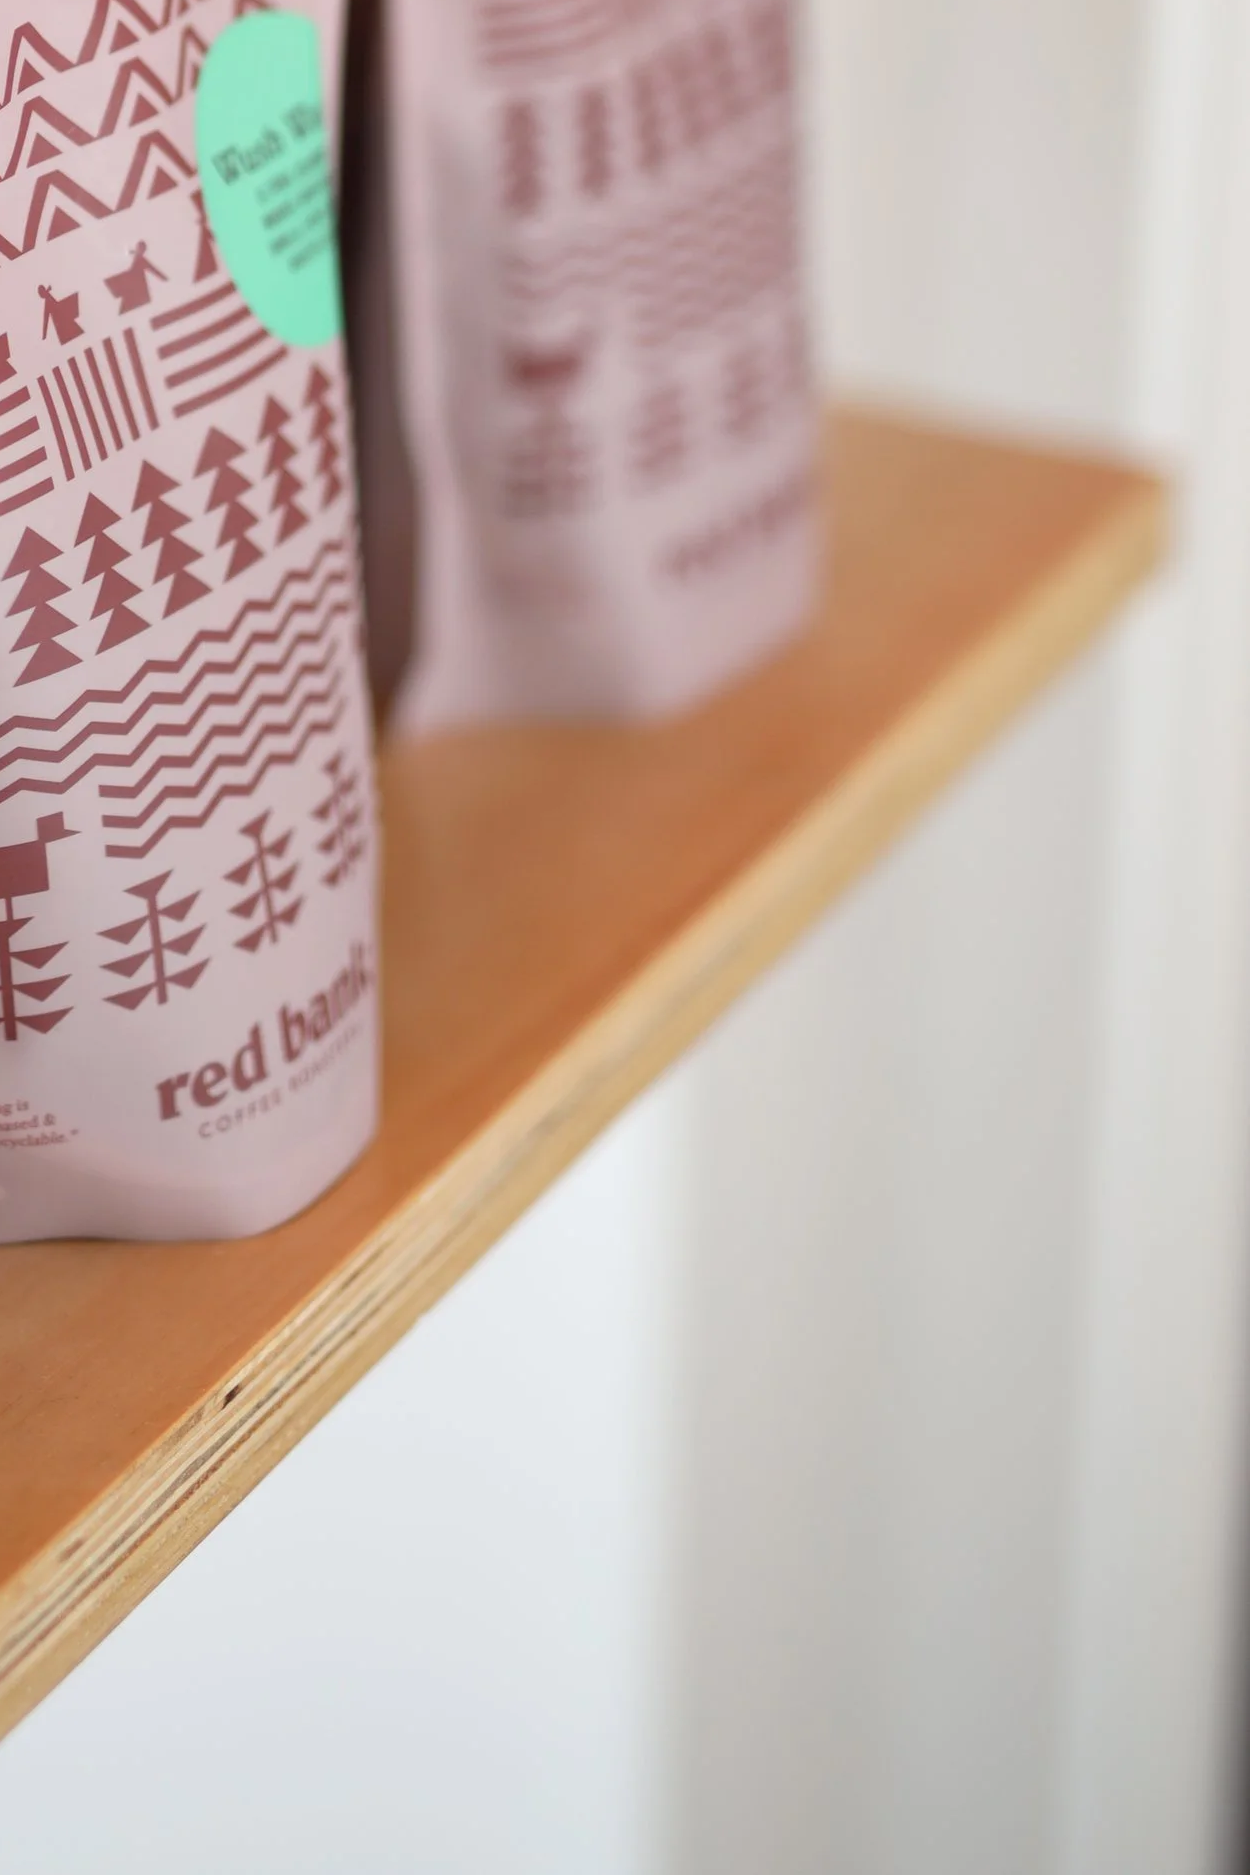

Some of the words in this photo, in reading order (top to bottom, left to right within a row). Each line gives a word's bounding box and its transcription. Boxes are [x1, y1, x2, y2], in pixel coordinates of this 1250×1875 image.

[155, 1019, 269, 1121] red
[16, 1098, 29, 1112] is
[43, 1111, 56, 1127] &
[198, 1087, 282, 1139] COFFEE
